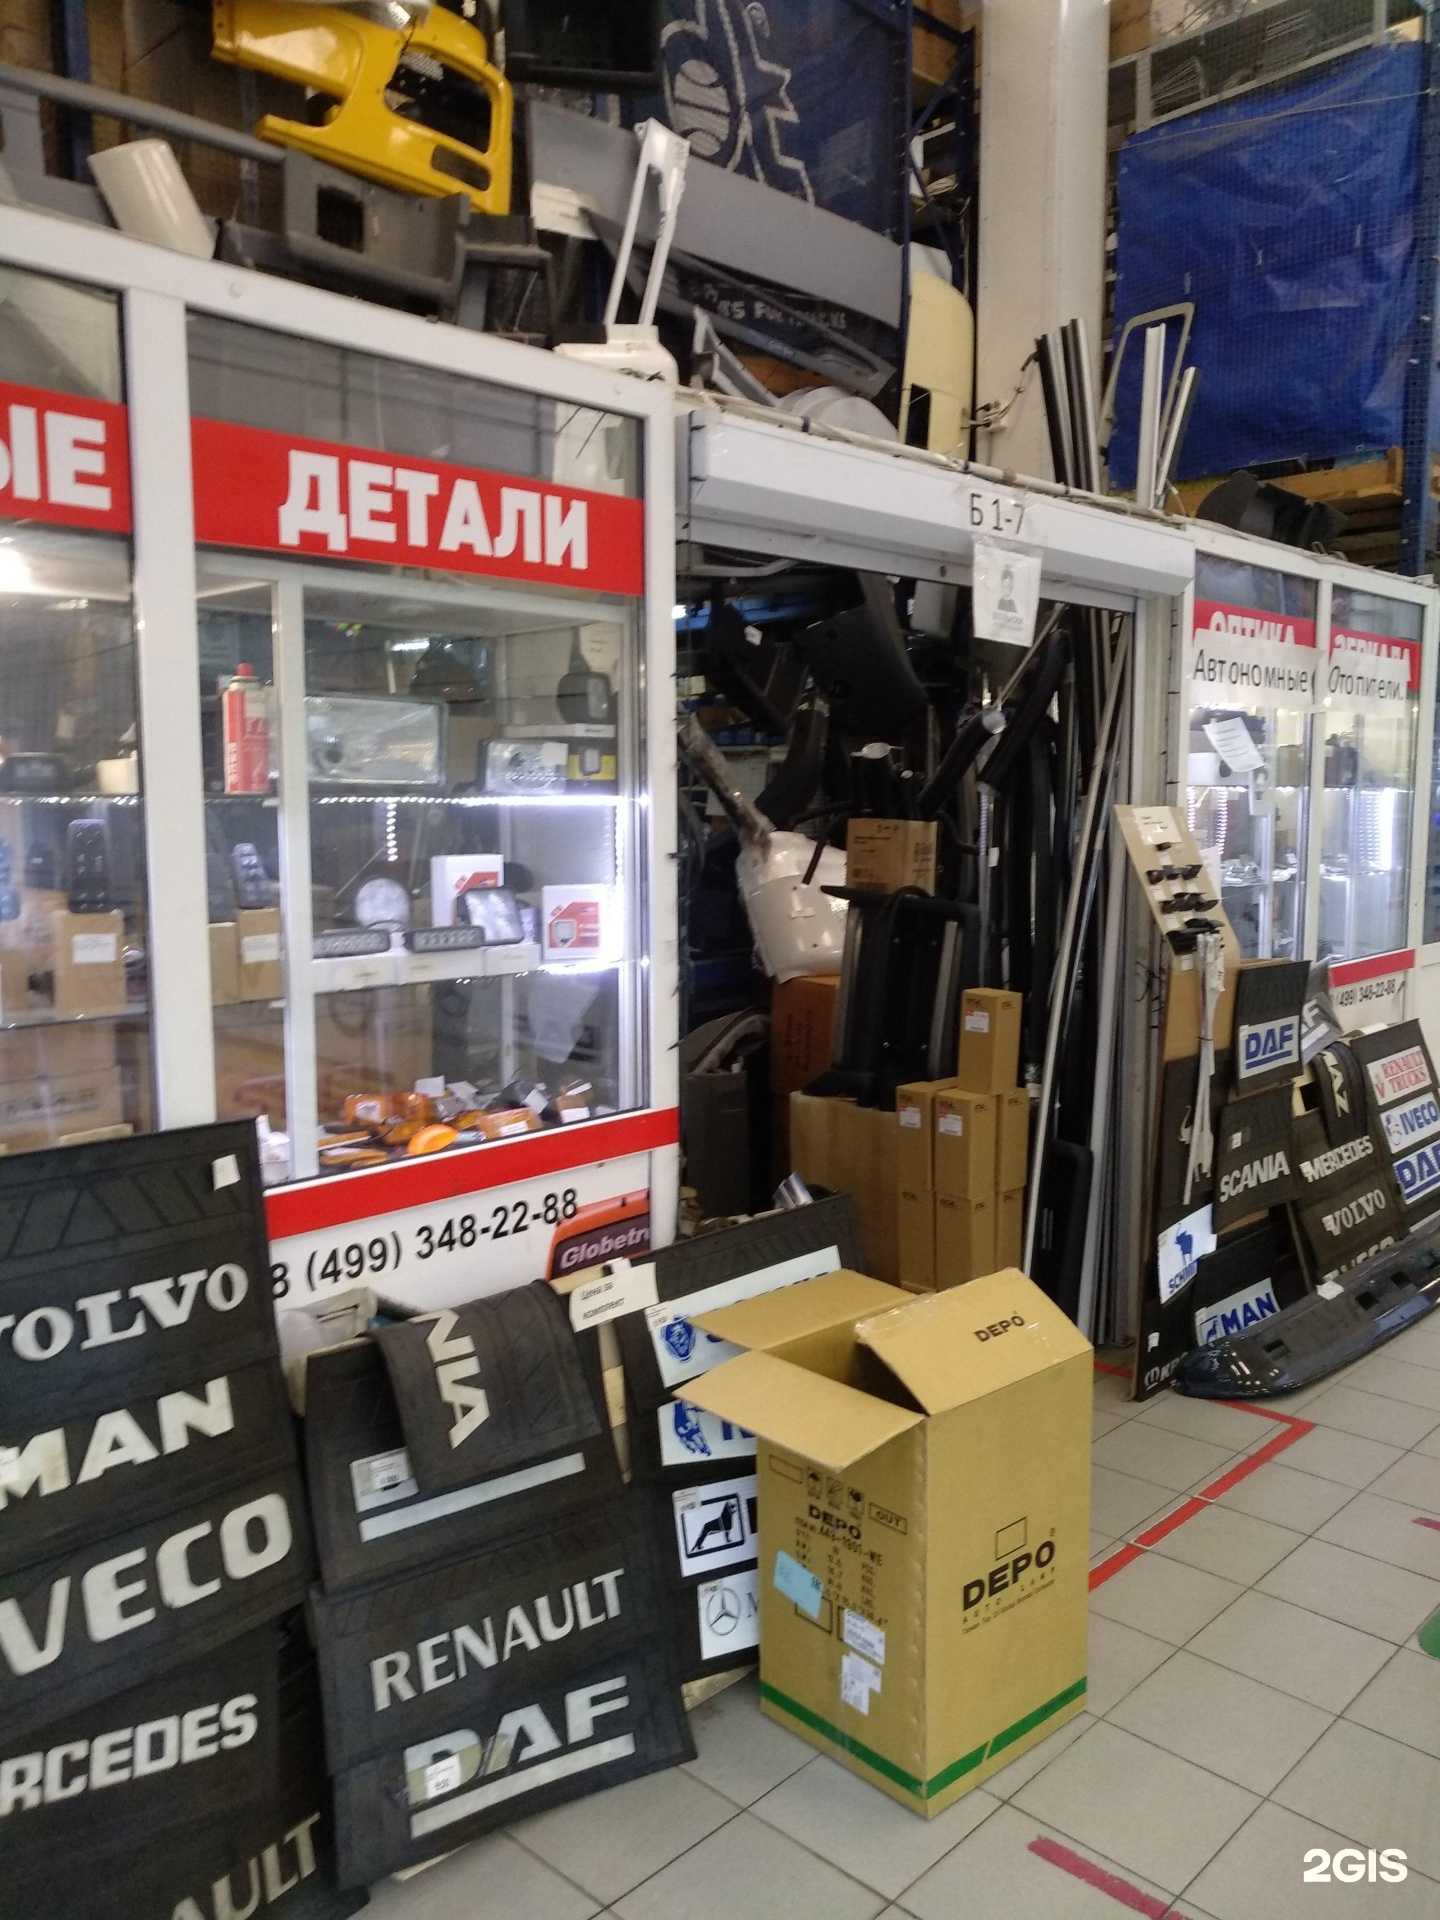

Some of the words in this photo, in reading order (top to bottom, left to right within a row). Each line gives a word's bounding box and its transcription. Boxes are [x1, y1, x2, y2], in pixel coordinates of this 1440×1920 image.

[278, 450, 589, 570] ДЕТАЛИ
[969, 492, 984, 527] Б
[991, 498, 1026, 535] 1-7
[1193, 649, 1308, 694] Автономные
[1244, 1023, 1294, 1060] DAF
[1400, 1100, 1439, 1138] IVECO
[1219, 1150, 1291, 1204] SCANIA
[1303, 1134, 1374, 1183] MERCEDES
[1323, 1188, 1387, 1237] VOLVO
[272, 1262, 290, 1300] 8
[305, 1230, 402, 1293] (499)
[416, 1187, 579, 1262] 348-22-88
[560, 1223, 650, 1271] Globetr
[973, 1314, 1026, 1343] DEPO
[1221, 1291, 1278, 1336] MAN
[807, 1503, 863, 1541] DEPO
[962, 1540, 1056, 1611] DEPO
[369, 1567, 625, 1713] RENAULT
[404, 1675, 630, 1807] DAF
